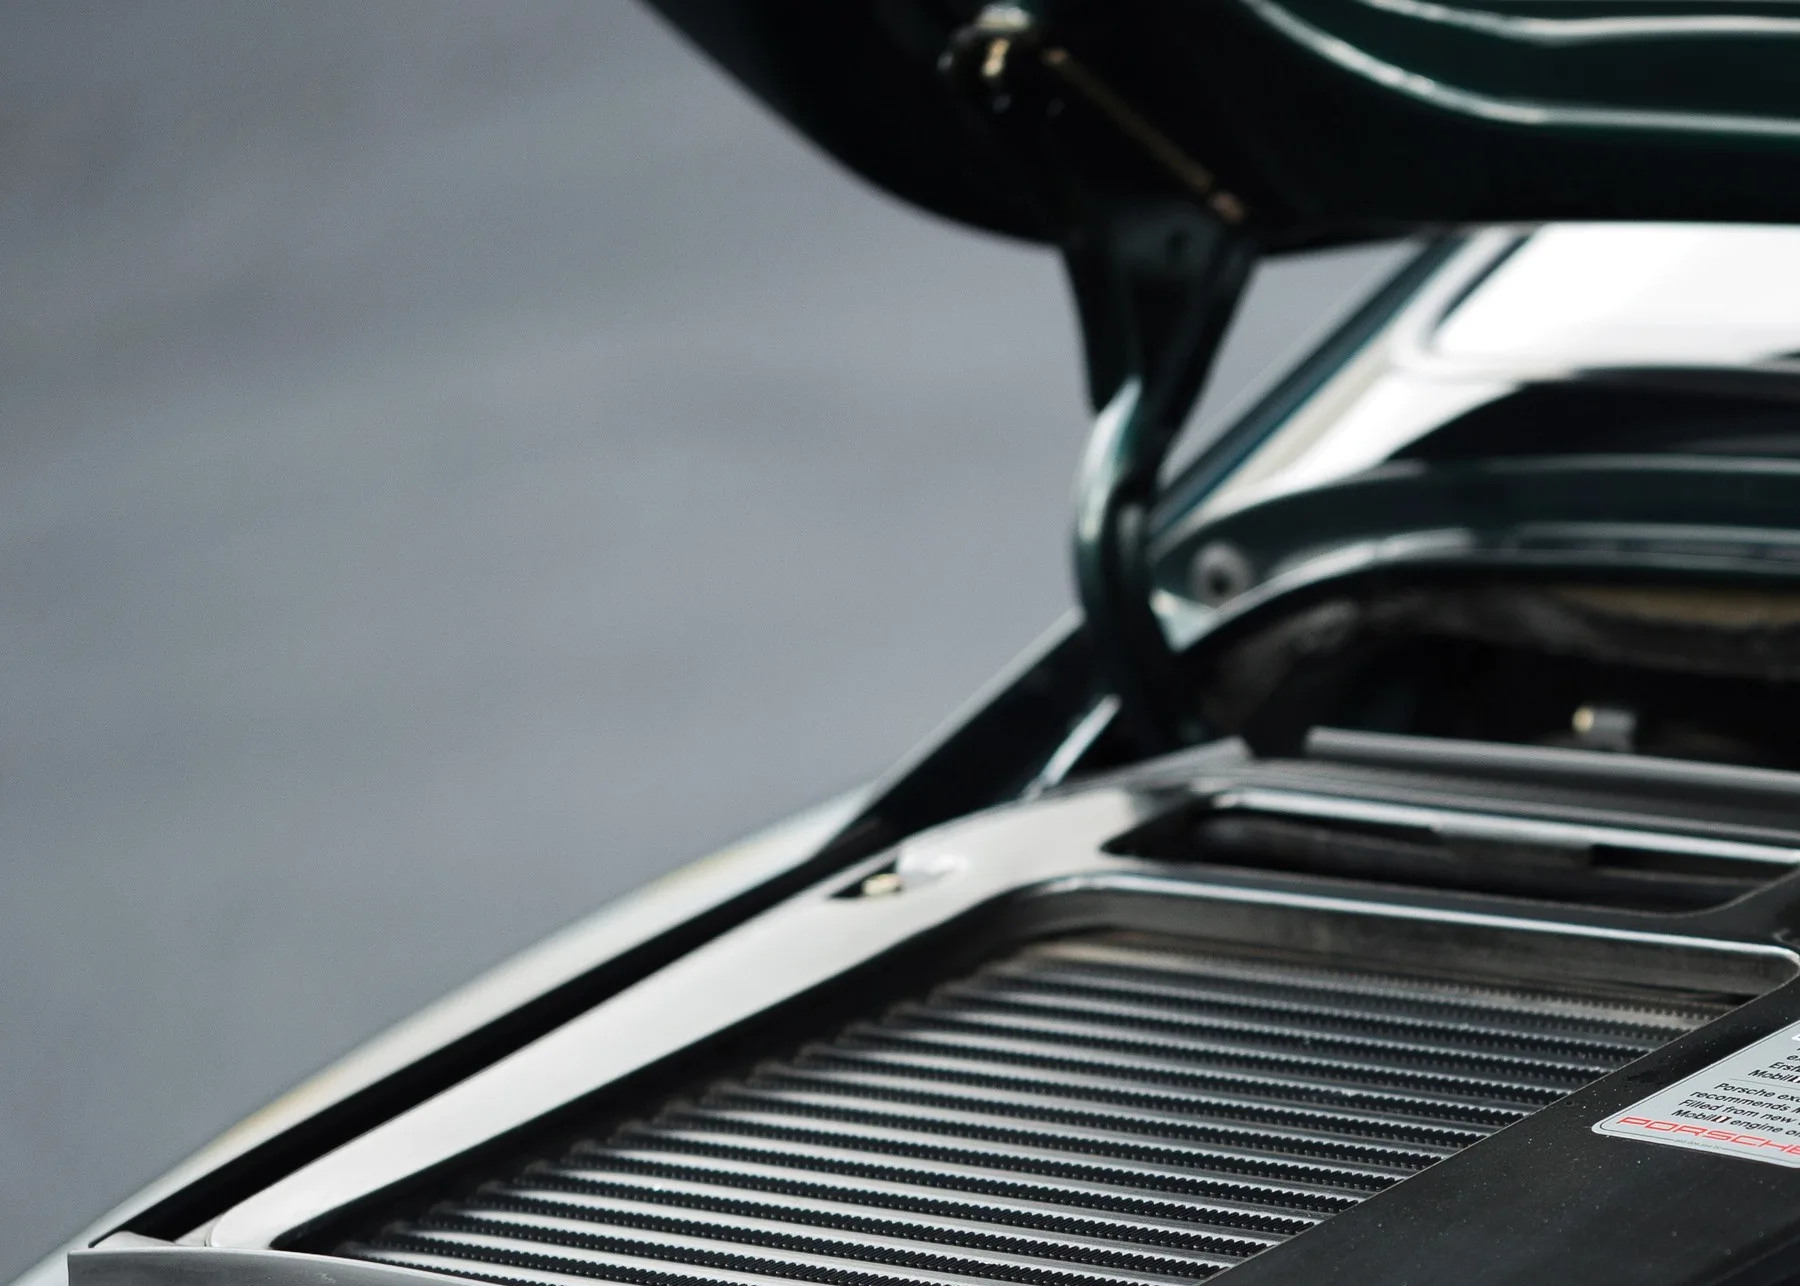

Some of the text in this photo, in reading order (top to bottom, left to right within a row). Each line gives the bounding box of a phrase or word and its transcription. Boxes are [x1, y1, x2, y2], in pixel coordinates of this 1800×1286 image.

[1713, 1082, 1775, 1097] Porsche
[1689, 1091, 1791, 1111] recommends
[1678, 1099, 1725, 1111] Filled
[1722, 1106, 1759, 1117] from
[1760, 1113, 1796, 1123] new
[1729, 1120, 1783, 1132] engine
